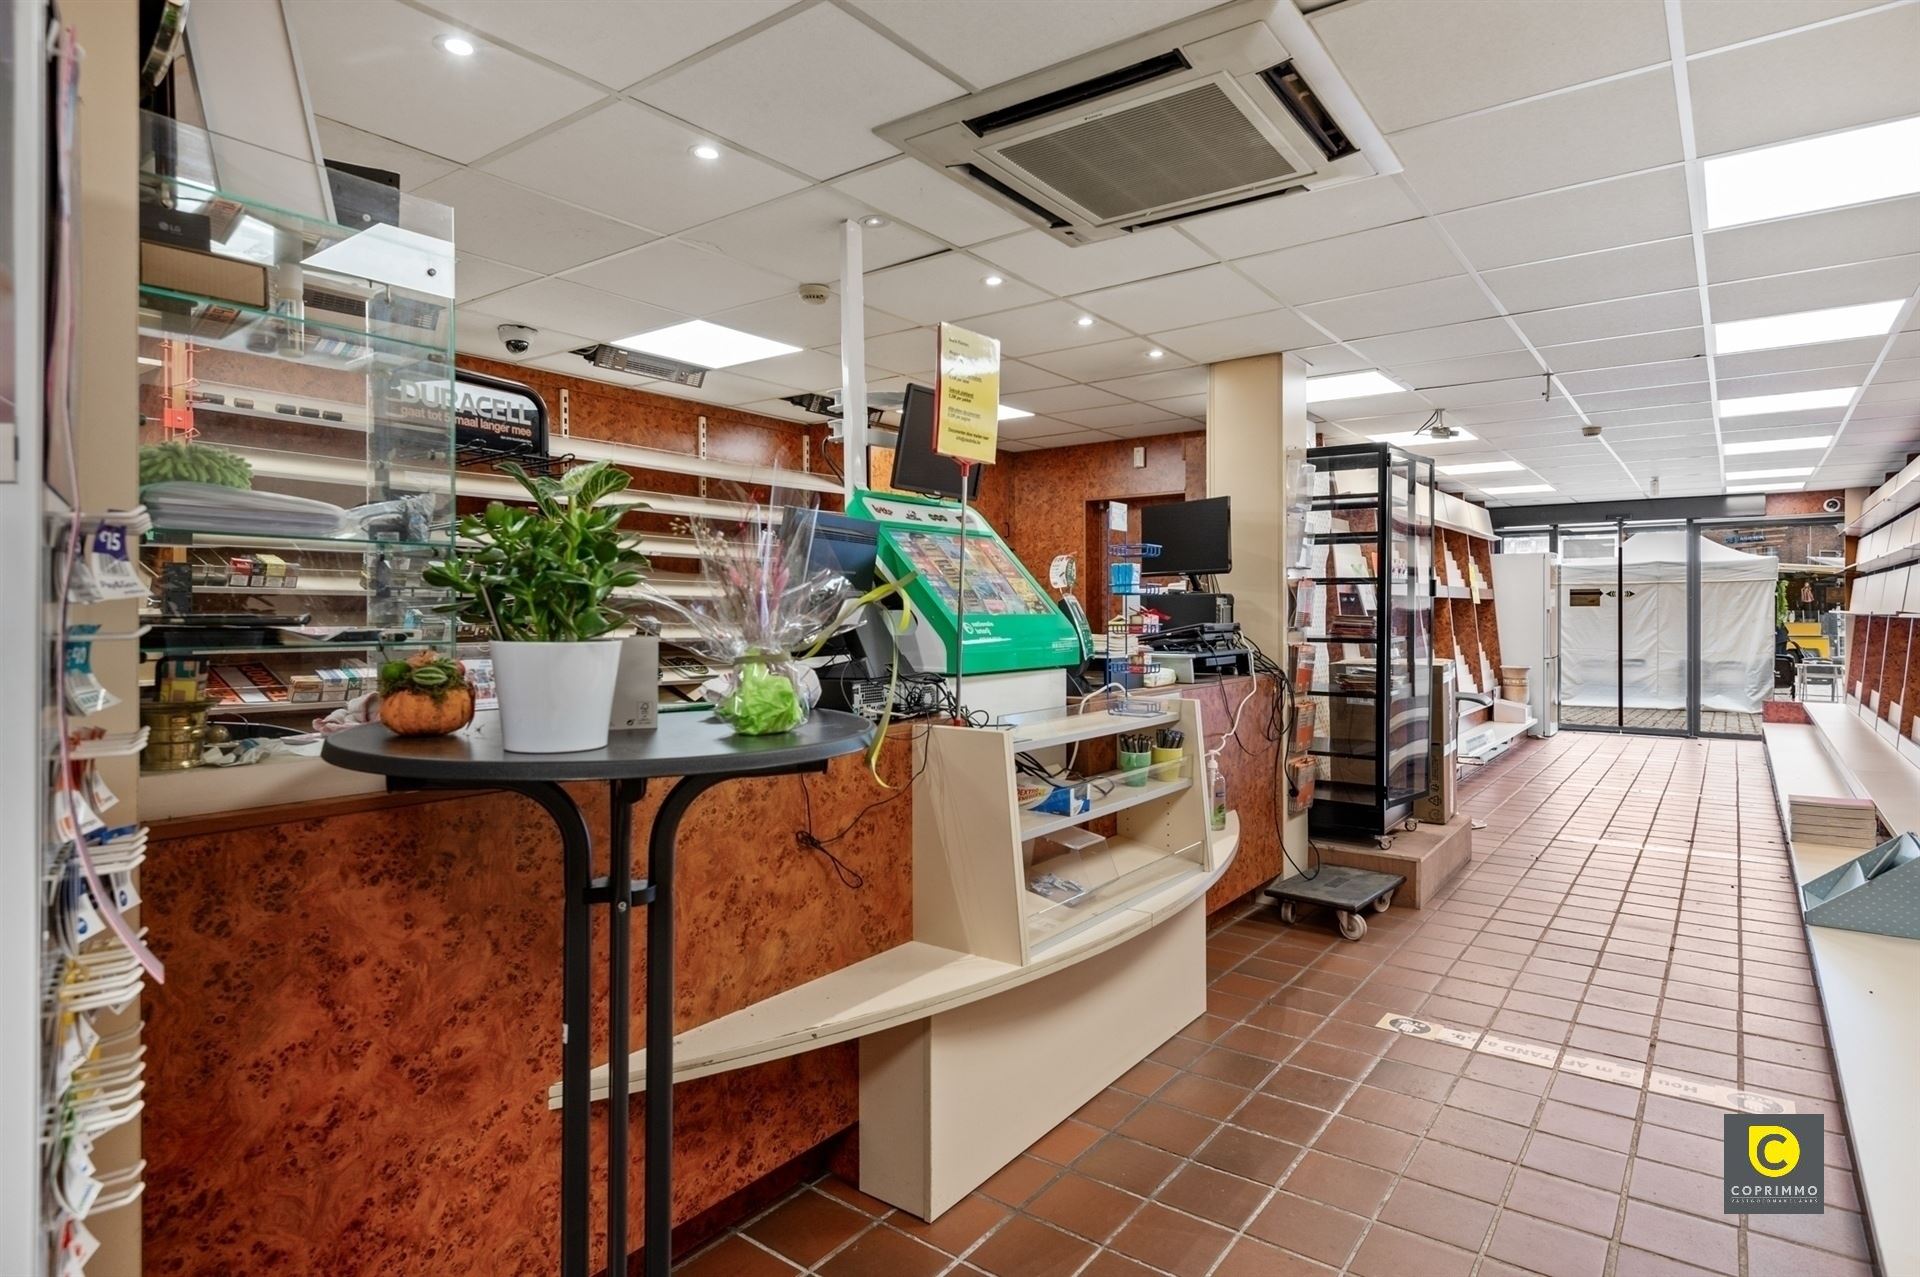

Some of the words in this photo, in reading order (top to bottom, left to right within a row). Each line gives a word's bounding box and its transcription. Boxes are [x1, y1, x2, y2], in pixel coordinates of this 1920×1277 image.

[400, 379, 532, 425] DURACELL
[400, 406, 426, 418] gaat
[428, 409, 443, 421] tot
[455, 416, 479, 428] maal
[480, 418, 510, 434] langer
[511, 427, 533, 437] mee
[1503, 1045, 1589, 1068] AFTAND
[1658, 1079, 1698, 1094] Hou
